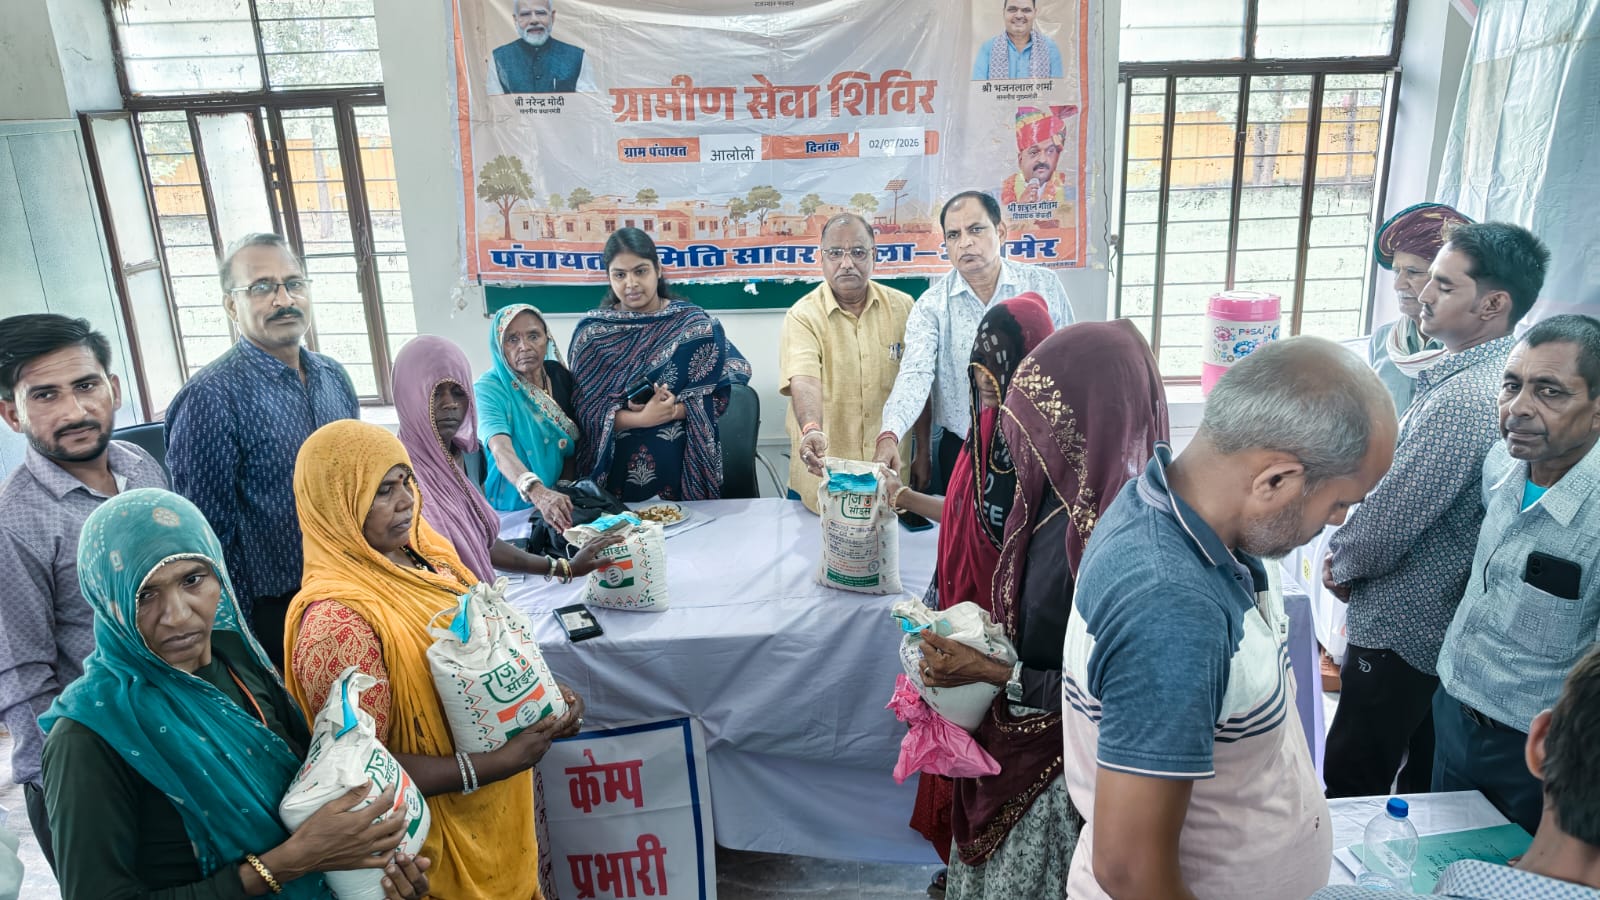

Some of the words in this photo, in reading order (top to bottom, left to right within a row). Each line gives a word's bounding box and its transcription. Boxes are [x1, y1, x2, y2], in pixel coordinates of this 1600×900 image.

[994, 83, 1034, 92] भजनलाल
[1036, 80, 1053, 91] शर्मा
[525, 96, 546, 106] नरेन्द्र
[547, 96, 565, 106] मोदी
[609, 74, 737, 122] ग्रामीण
[744, 74, 820, 121] सेवा
[827, 70, 938, 118] शिविर
[624, 145, 646, 159] ग्राम
[649, 143, 688, 158] पंचायत
[710, 148, 755, 162] आलोली
[805, 141, 840, 154] दिनांक
[655, 244, 728, 268] मिति
[732, 245, 820, 265] सावर
[479, 661, 517, 688] राज
[566, 833, 668, 900] प्रभारी
